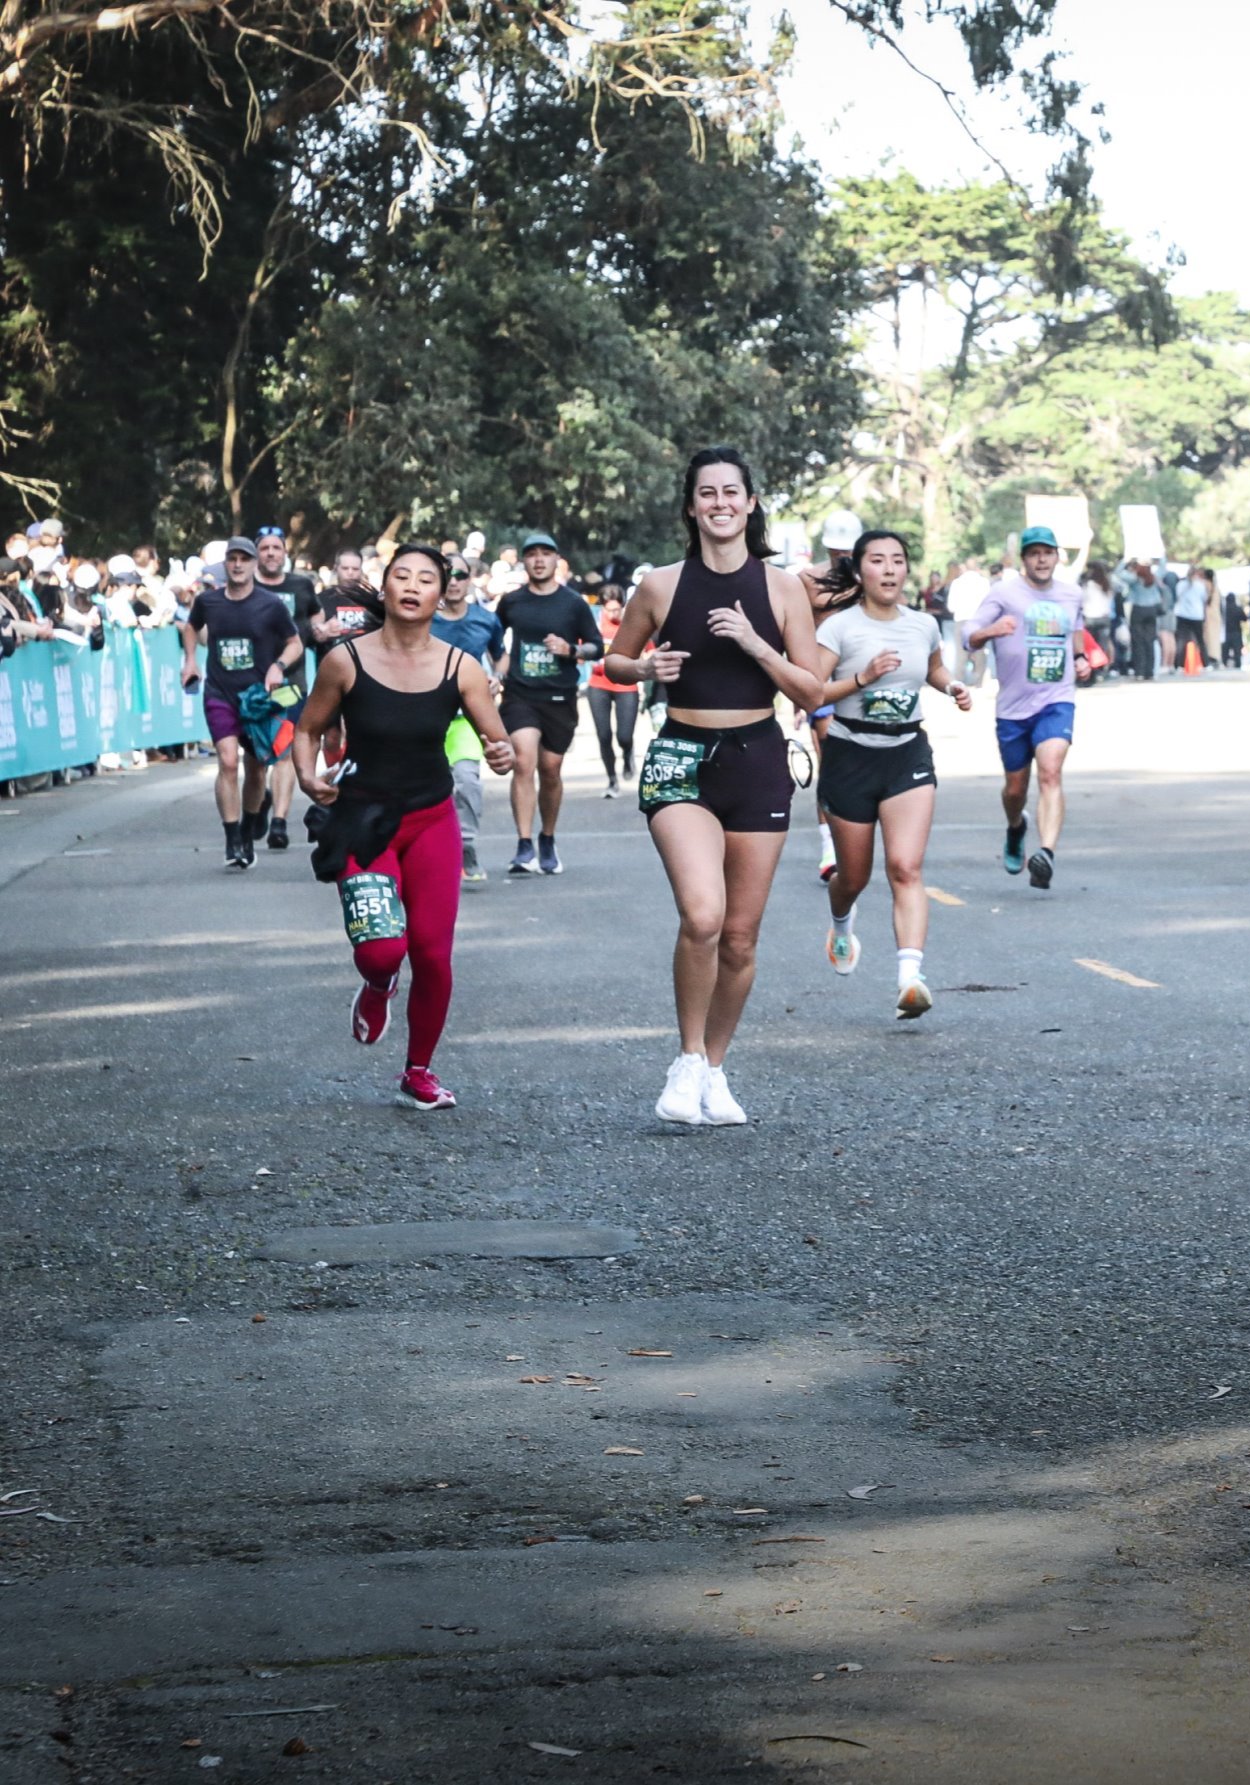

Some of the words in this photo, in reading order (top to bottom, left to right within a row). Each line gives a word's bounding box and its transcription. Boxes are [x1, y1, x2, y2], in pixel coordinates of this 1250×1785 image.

[1032, 655, 1062, 668] 2237
[644, 764, 687, 783] 3085
[349, 898, 391, 919] 1551
[349, 916, 369, 930] HALF
